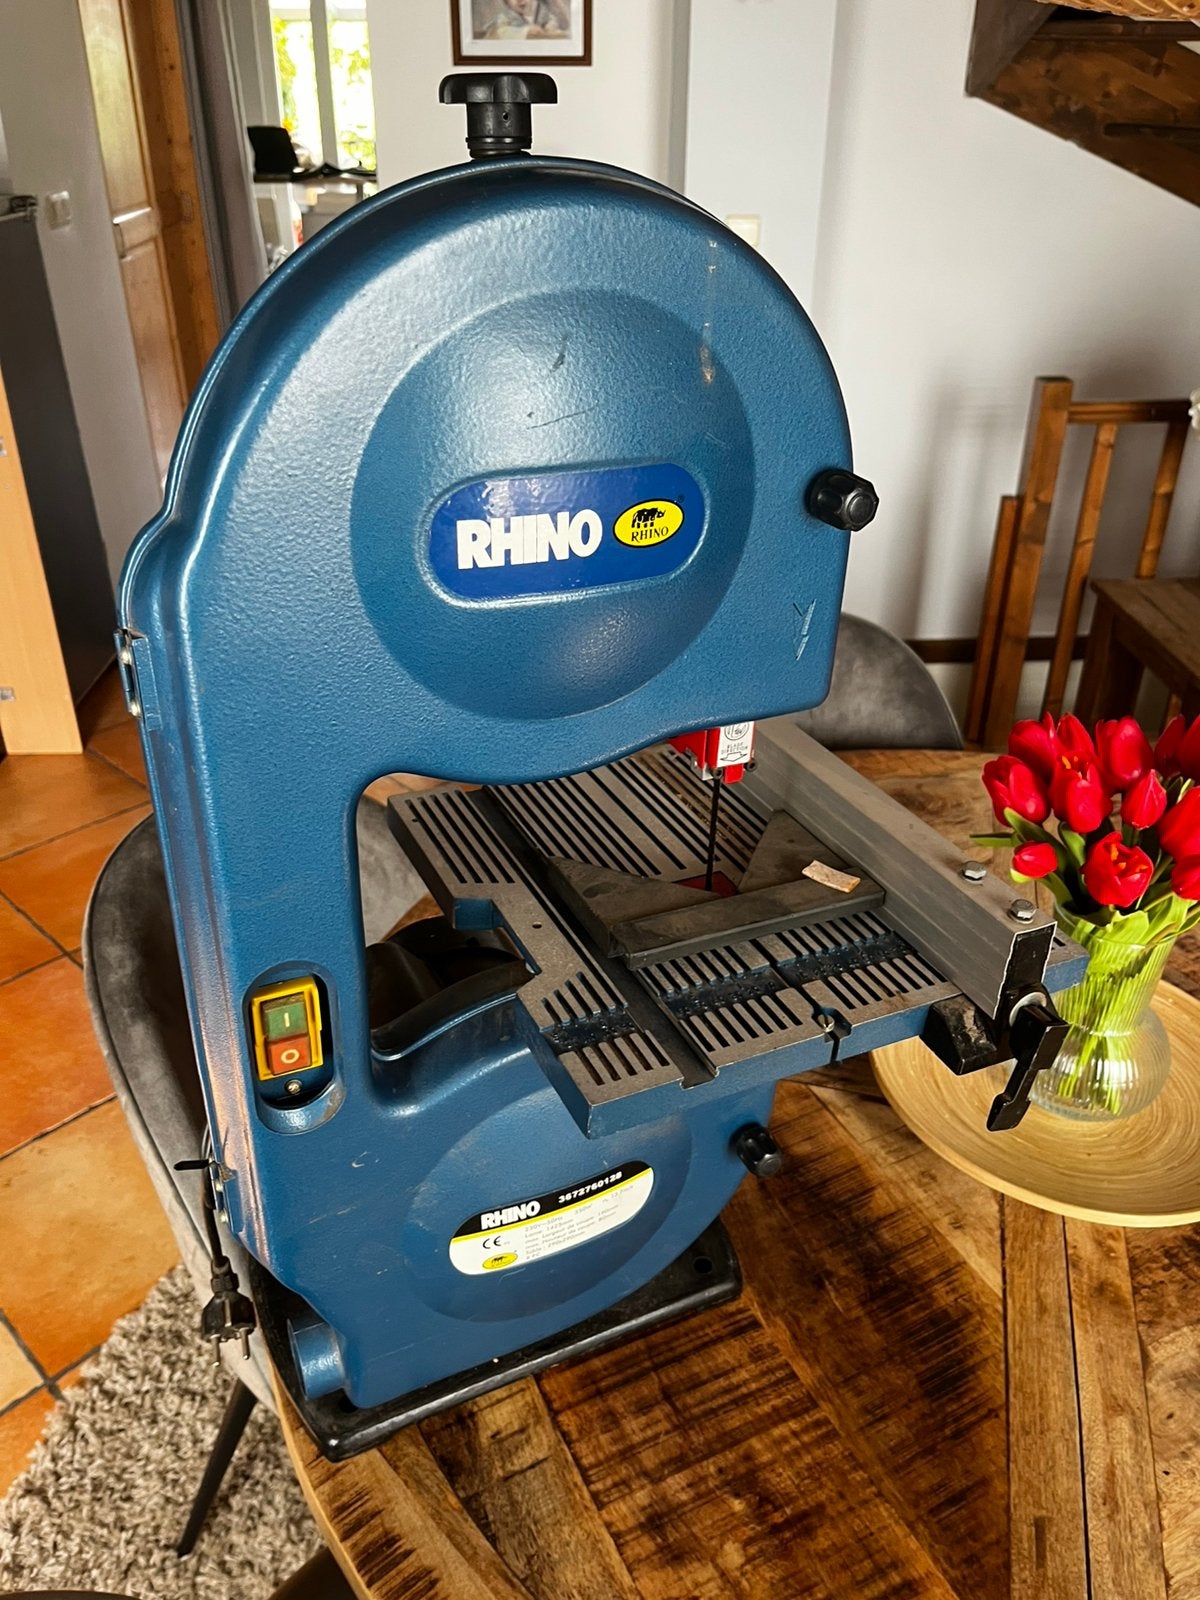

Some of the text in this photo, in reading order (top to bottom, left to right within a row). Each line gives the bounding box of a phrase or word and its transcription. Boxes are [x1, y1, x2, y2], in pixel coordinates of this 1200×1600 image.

[456, 509, 602, 569] RHINO
[631, 526, 669, 543] RHINO
[481, 1200, 541, 1230] RHINO
[557, 1171, 623, 1204] 3672760128
